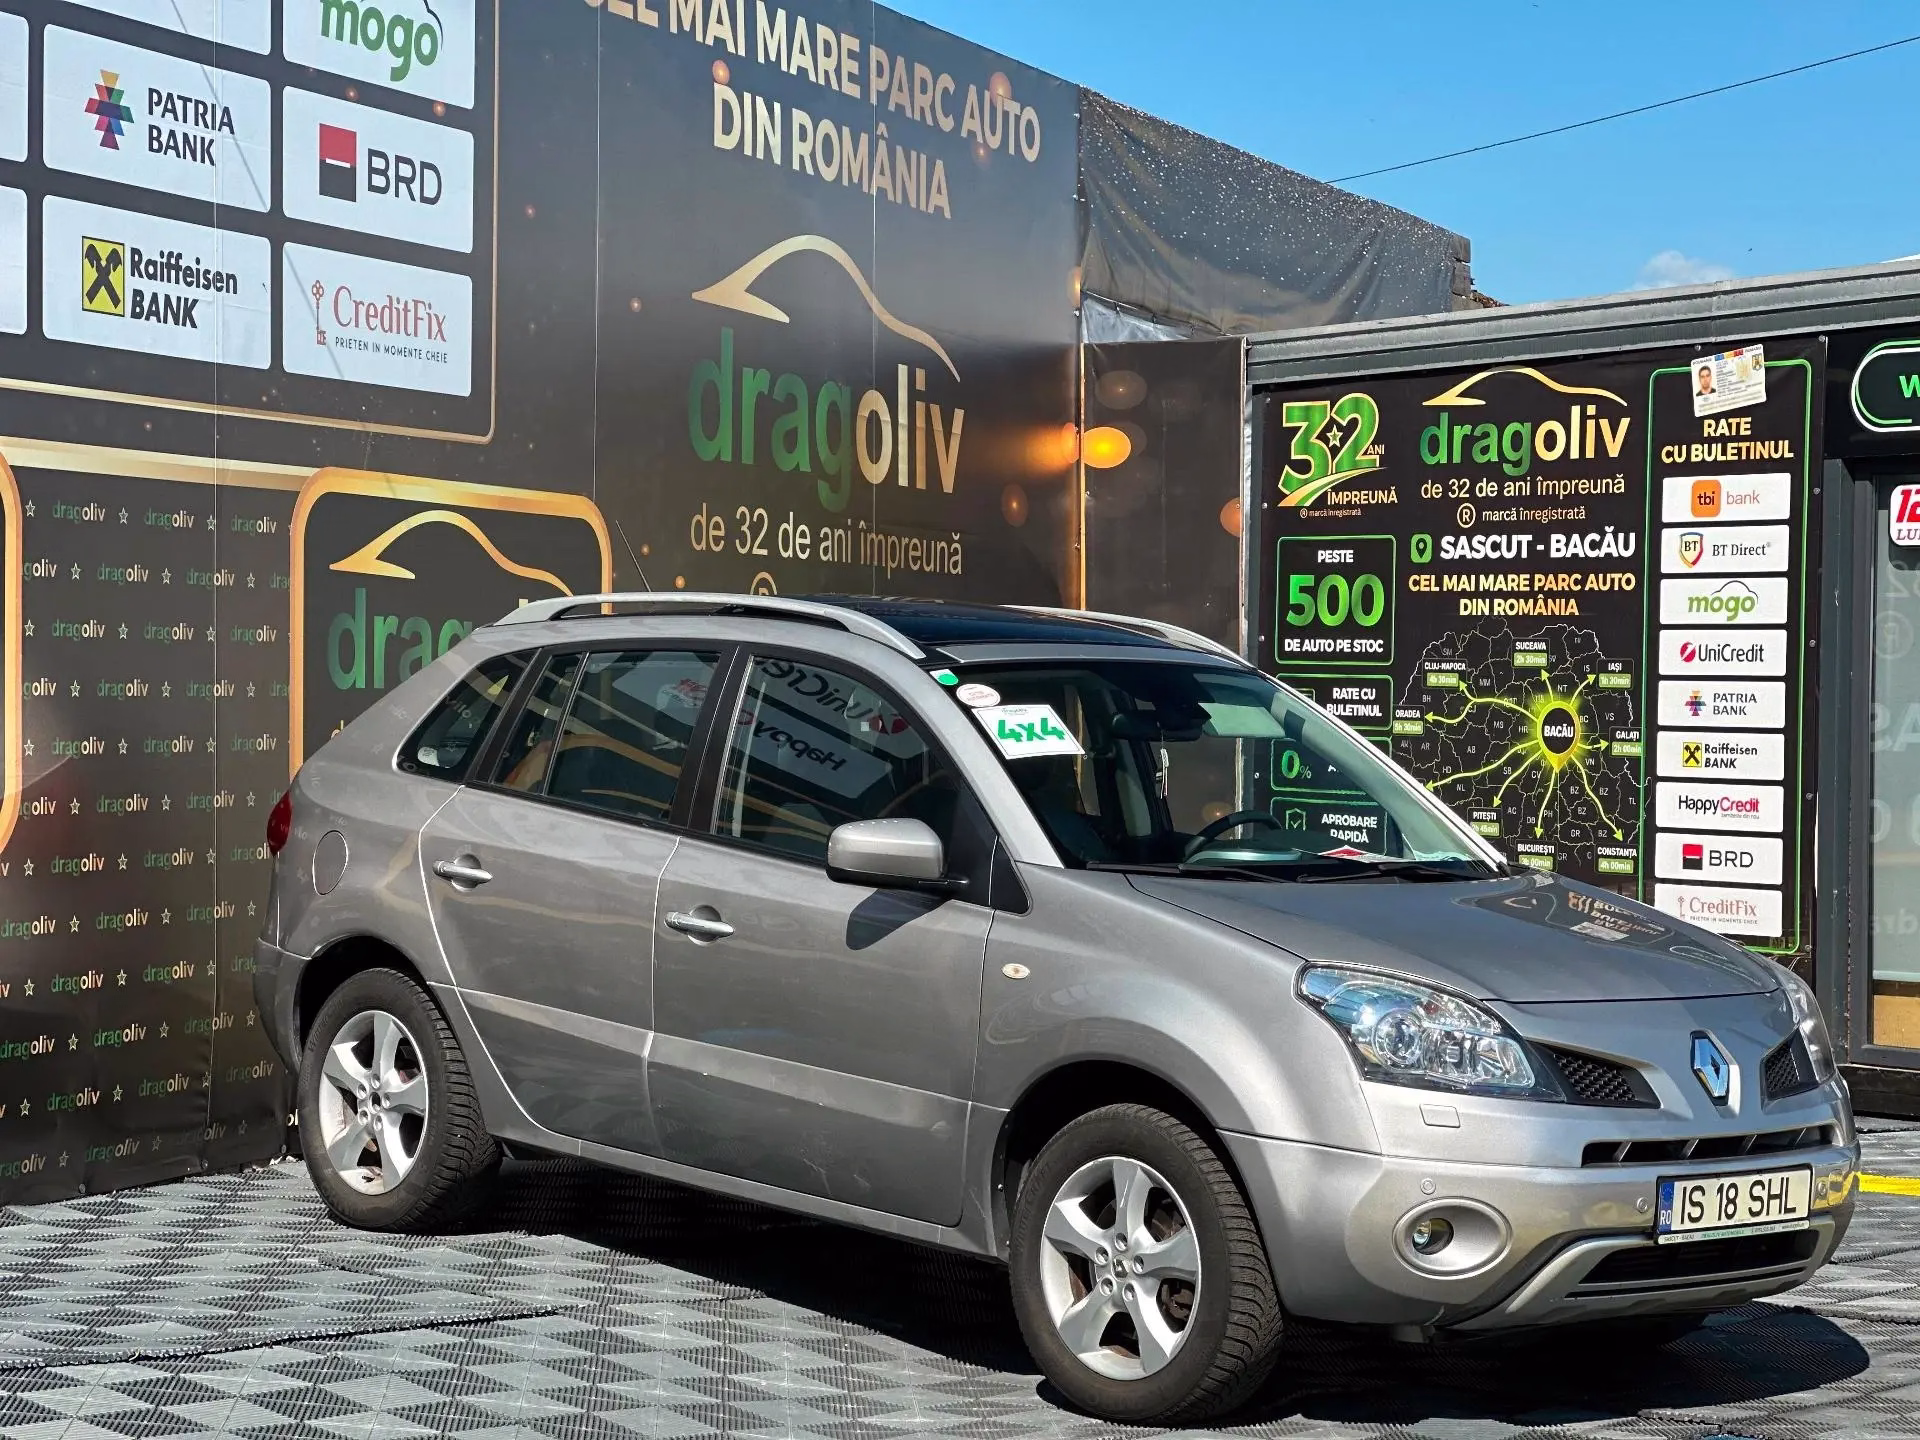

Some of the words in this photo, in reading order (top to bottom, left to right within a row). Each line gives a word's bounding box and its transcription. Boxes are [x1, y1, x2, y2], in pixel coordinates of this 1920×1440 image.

[320, 0, 439, 81] mogo
[757, 5, 861, 99] MARE
[869, 44, 955, 133] PARC
[960, 84, 1040, 163] AUTO
[147, 88, 235, 135] PATRIA
[147, 124, 216, 166] BANK
[713, 82, 782, 166] DIN
[792, 108, 951, 219] ROMÂNIA
[368, 147, 442, 206] BRD
[130, 247, 238, 295] Raiffeisen
[130, 289, 198, 329] BANK
[333, 285, 447, 343] CreditFix
[335, 336, 369, 352] PRIETEN
[372, 342, 380, 353] IN
[384, 343, 422, 360] MOMENTE
[425, 349, 448, 364] CHEIE
[689, 327, 965, 513] dragoliv
[1703, 417, 1752, 437] RATE
[1278, 392, 1379, 495] 32
[1367, 444, 1385, 455] ANI
[1419, 403, 1631, 476] dragoliv
[1661, 446, 1687, 463] CU
[1691, 440, 1794, 463] BULETINUL
[1327, 486, 1398, 506] ÎMPREUNĂ
[1421, 479, 1443, 499] de
[1448, 478, 1470, 498] 32
[1475, 477, 1498, 497] de
[1503, 477, 1531, 496] ani
[1536, 474, 1625, 500] împreună
[1697, 490, 1715, 506] tbi
[1726, 490, 1761, 505] bank
[53, 503, 105, 522] dragoliv
[144, 508, 194, 530] dragoliv
[231, 514, 277, 535] dragoliv
[1482, 507, 1517, 522] marcă
[1519, 505, 1586, 523] înregistrată
[690, 502, 725, 552] de
[735, 506, 769, 557] 32
[778, 511, 811, 560] de
[819, 519, 852, 564] ani
[860, 521, 963, 578] împreună
[1439, 534, 1532, 560] SASCUT
[1550, 526, 1636, 559] BACĂU
[1684, 541, 1698, 552] BT
[1712, 544, 1728, 557] BT
[1317, 549, 1354, 563] PESTE
[97, 563, 148, 584] dragoliv
[187, 567, 235, 588] dragoliv
[1409, 575, 1440, 592] CEL
[1443, 574, 1478, 592] MAI
[1480, 574, 1530, 592] MARE
[1534, 574, 1582, 592] PARC
[1585, 572, 1636, 592] AUTO
[1286, 573, 1385, 627] 500
[1459, 599, 1491, 616] DIN
[1494, 594, 1579, 616] ROMÂNIA
[1688, 594, 1756, 622] mogo
[52, 619, 105, 641] dragoliv
[144, 622, 194, 643] dragoliv
[231, 624, 277, 644] dragoliv
[1284, 640, 1300, 652] DE
[1302, 639, 1333, 652] AUTO
[1335, 639, 1351, 652] PE
[1353, 638, 1384, 653] STOC
[1515, 642, 1546, 650] SUCEAVA
[1698, 643, 1765, 663] UniCredit
[1424, 662, 1466, 670] CLUJ-NAPOCA
[97, 678, 148, 700] dragoliv
[186, 679, 235, 701] dragoliv
[1333, 688, 1359, 700] RATE
[1360, 688, 1376, 700] CU
[1713, 692, 1757, 704] PATRIA
[1327, 704, 1382, 717] BULETINUL
[1395, 709, 1420, 718] ORADEA
[1713, 705, 1748, 716] BANK
[1544, 724, 1573, 737] BACĂU
[51, 736, 105, 758] dragoliv
[144, 735, 194, 757] dragoliv
[231, 733, 276, 753] dragoliv
[1704, 743, 1758, 756] Raiffeisen
[1281, 750, 1312, 779] 0%
[1704, 757, 1737, 769] BANK
[97, 793, 148, 816] dragoliv
[186, 789, 235, 812] dragoliv
[1678, 795, 1760, 815] HappyCredit
[1321, 813, 1378, 829] APROBARE
[51, 853, 105, 876] dragoliv
[143, 848, 194, 870] dragoliv
[230, 843, 270, 865] dragoli
[1709, 850, 1754, 869] BRD
[1690, 897, 1757, 916] CreditFix
[1, 915, 56, 940] dragoliv
[96, 908, 149, 932] dragoliv
[186, 902, 235, 924] dragoliv
[50, 971, 103, 994] dragoliv
[143, 960, 194, 984] dragoliv
[93, 1023, 147, 1048] dragoliv
[185, 1011, 234, 1035] dragoliv
[47, 1087, 100, 1111] dragoliv
[138, 1074, 190, 1098] dragoliv
[1680, 1185, 1706, 1224] IS
[1716, 1182, 1739, 1221] 18
[1748, 1177, 1797, 1217] SHL
[1660, 1210, 1671, 1226] RO
